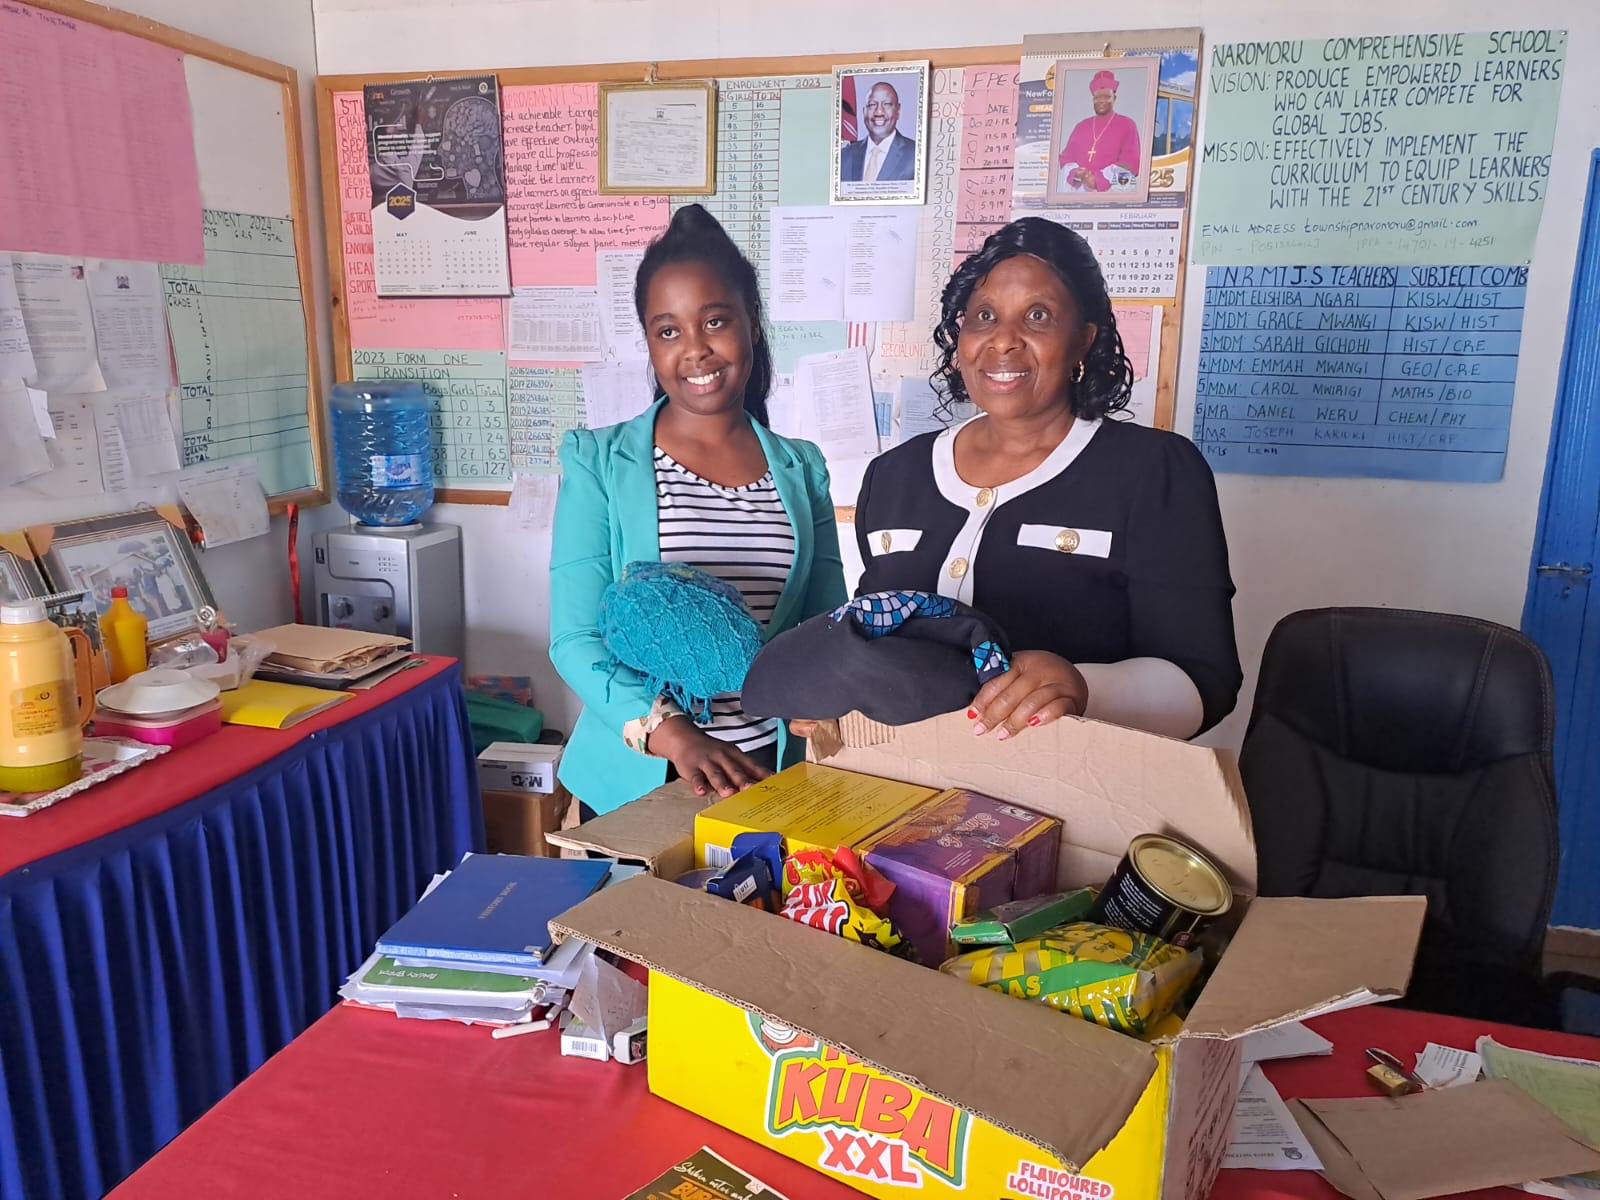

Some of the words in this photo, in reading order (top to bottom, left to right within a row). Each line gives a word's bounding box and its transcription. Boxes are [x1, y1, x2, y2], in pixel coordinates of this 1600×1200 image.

[1211, 40, 1304, 68] NAROMORU
[1322, 32, 1465, 62] COMPREHENSIVE
[1211, 71, 1272, 94] VISION:
[1275, 67, 1351, 91] PRODUCE
[1364, 62, 1462, 87] EMPOWERED
[1474, 58, 1563, 82] LEARNERS
[726, 80, 786, 90] ENROLMENT
[795, 78, 821, 89] 2023
[1274, 92, 1308, 112] WHO
[1314, 90, 1345, 111] CAN
[1353, 87, 1399, 108] LATER
[1405, 84, 1477, 107] COMPETE
[1491, 82, 1524, 103] FOR
[987, 103, 1009, 114] DATE
[939, 117, 956, 133] 18
[1272, 113, 1328, 136] GLOBAL
[1338, 111, 1388, 134] JOBS.
[936, 133, 956, 148] 24
[1202, 141, 1270, 164] MISSION:
[1273, 136, 1374, 161] EFFECTIVELY
[1385, 132, 1478, 157] IMPLEMENT
[1494, 131, 1528, 153] THE
[935, 148, 955, 161] 24
[935, 162, 955, 176] 25
[1271, 161, 1369, 186] CURRICULUM
[1379, 160, 1400, 183] TO
[1405, 158, 1460, 182] EQUIP
[1469, 155, 1552, 179] LEARNERS
[934, 190, 954, 205] 30
[1270, 187, 1309, 210] WITH
[1318, 186, 1351, 208] THE
[1401, 182, 1478, 206] CENTURY
[1482, 180, 1543, 205] SKILLS.
[934, 205, 954, 219] 26
[1202, 224, 1241, 236] EMAIL
[1408, 265, 1480, 287] SUBJECT
[1480, 265, 1529, 287] COMB
[168, 281, 201, 294] TOTAL
[1250, 289, 1303, 306] ELISHIBA
[1314, 291, 1360, 308] NGARI
[1257, 310, 1304, 329] GRACE
[1319, 312, 1377, 330] MWANGI
[1201, 336, 1209, 350] 3
[1253, 335, 1304, 353] SARAH
[1315, 334, 1371, 353] GICHOHI
[354, 352, 386, 365] 2023
[396, 353, 426, 365] FORM
[443, 354, 470, 365] ONE
[371, 365, 451, 379] TRANSITION
[1199, 359, 1208, 370] 4
[1251, 359, 1304, 374] EMMAH
[1315, 359, 1369, 374] MWANGI
[183, 385, 214, 397] TOTAL
[451, 382, 475, 397] Girls
[1197, 377, 1206, 394] 5
[1250, 381, 1299, 396] CAROL
[1312, 382, 1363, 398] MWIRIGI
[1195, 403, 1203, 415] 6
[1208, 404, 1229, 419] MR
[1247, 403, 1296, 420] DANIEL
[1316, 406, 1359, 422] WERU
[456, 416, 472, 427] 22
[483, 416, 502, 429] 35
[460, 432, 473, 442] 17
[487, 432, 504, 443] 24
[1244, 425, 1294, 439] JOSEPH
[184, 434, 214, 447] TOTAL
[460, 447, 475, 460] 27
[461, 463, 479, 475] 66
[484, 462, 506, 475] 127
[778, 1061, 955, 1171] KUBA
[823, 1129, 918, 1184] XXL
[1020, 1162, 1112, 1198] FLAVOURED
